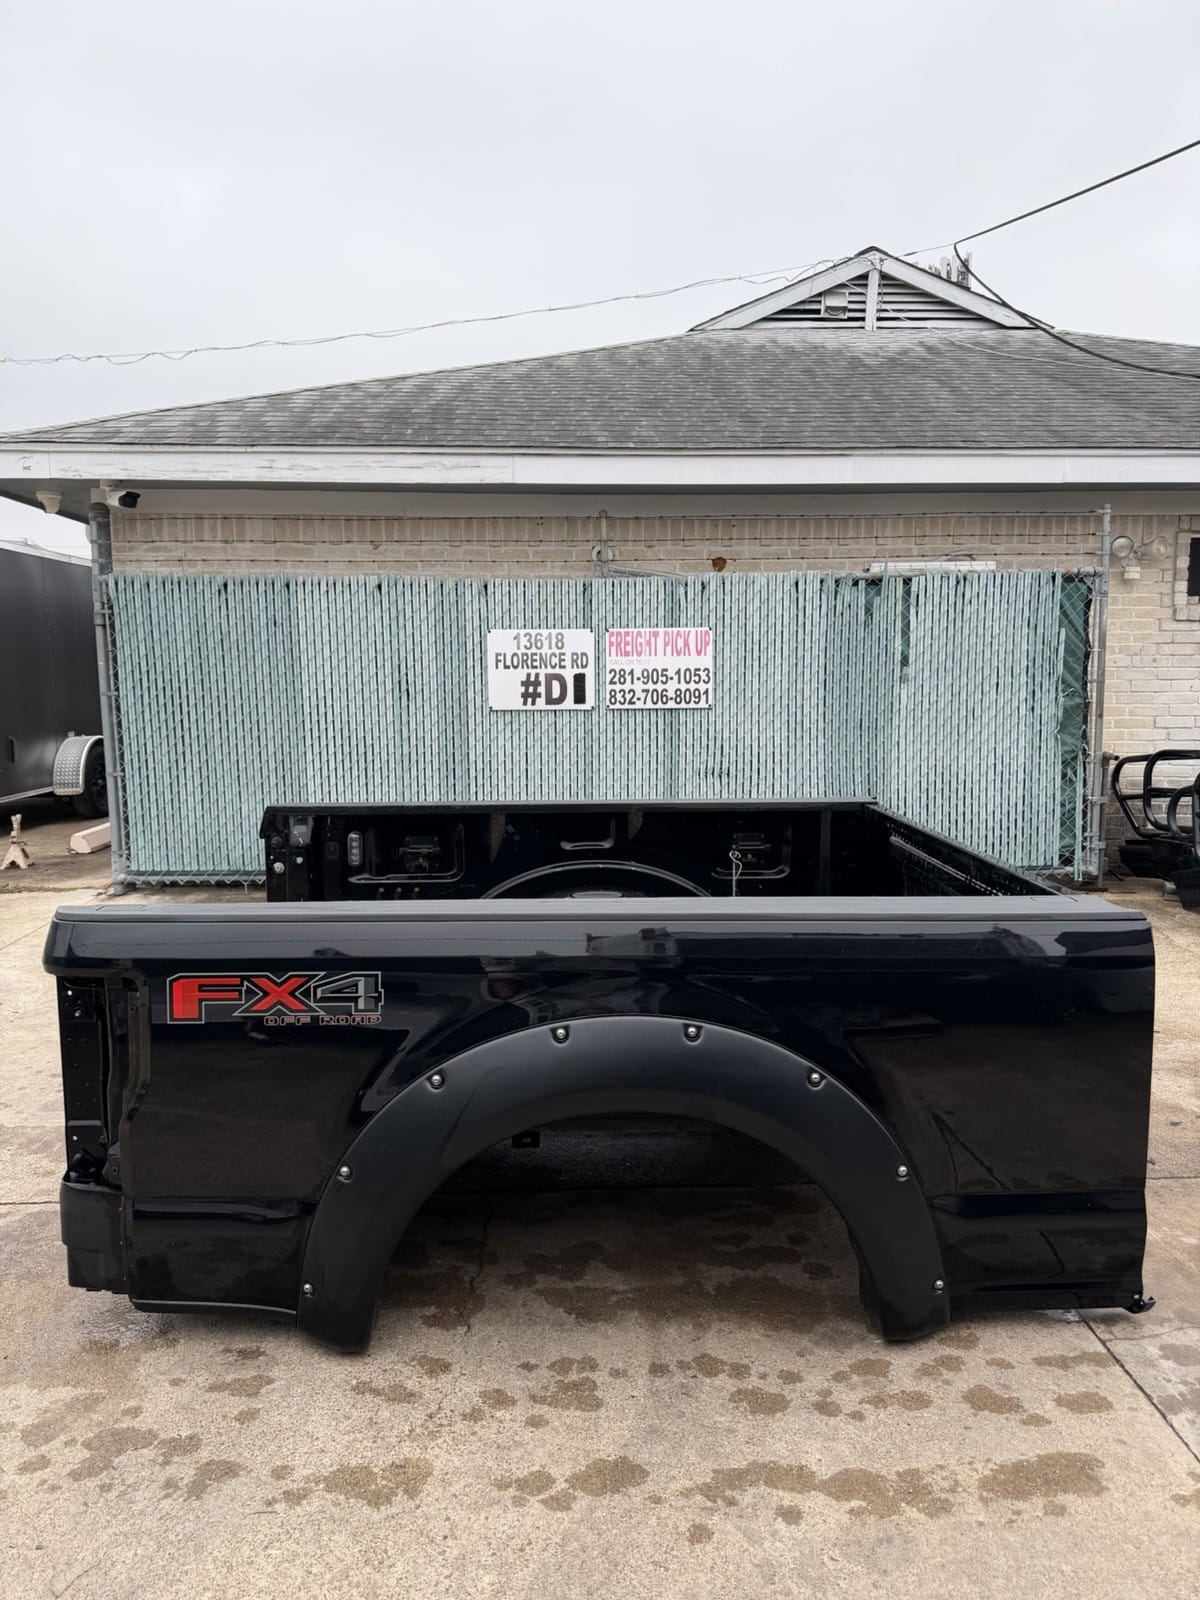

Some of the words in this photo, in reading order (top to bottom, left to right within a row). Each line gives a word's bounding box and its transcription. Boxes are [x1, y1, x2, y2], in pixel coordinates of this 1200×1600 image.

[513, 632, 565, 651] 13618
[608, 630, 660, 657] FREIGHT
[663, 630, 691, 657] PICK
[695, 630, 711, 656] UP
[495, 652, 567, 670] FLORENCE
[571, 652, 589, 669] RD
[608, 668, 711, 685] 281-905-1053
[608, 688, 710, 706] 832-706-8091
[167, 971, 384, 1024] FX4
[264, 1015, 312, 1026] OFF
[319, 1015, 382, 1026] ROAD
